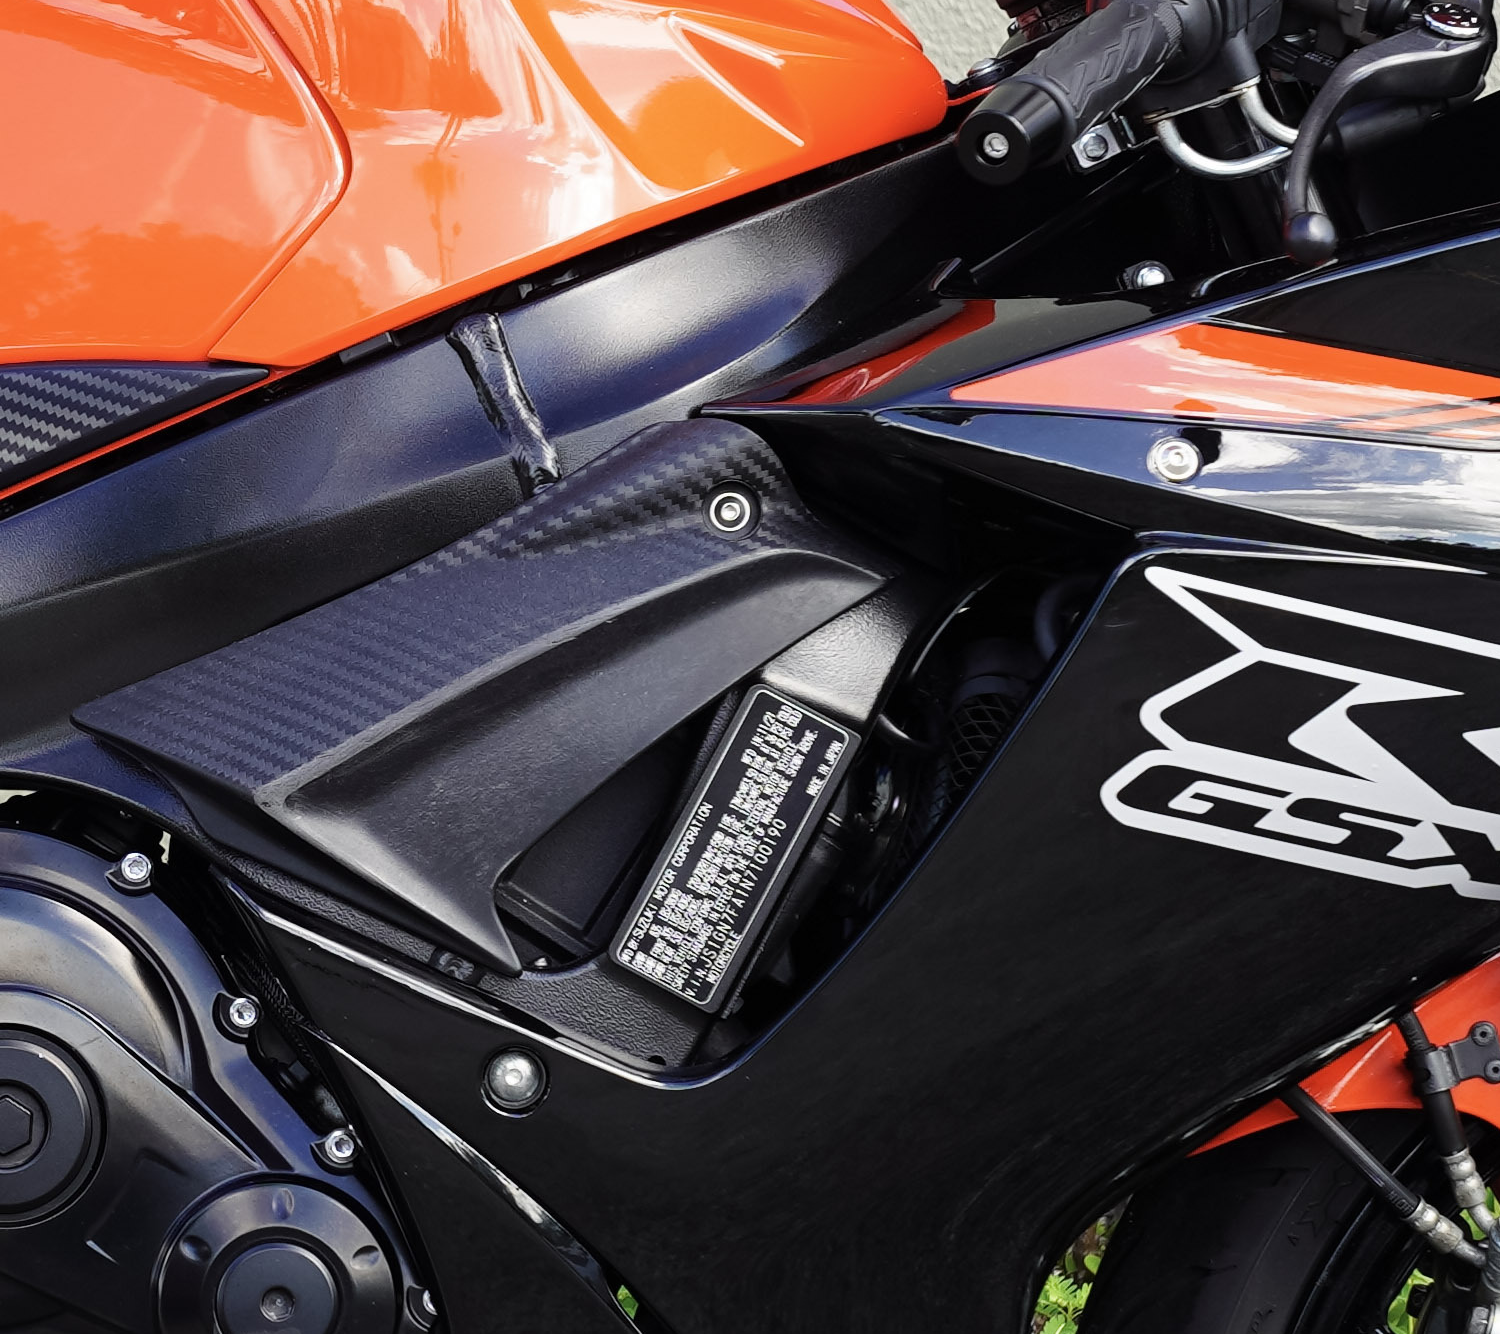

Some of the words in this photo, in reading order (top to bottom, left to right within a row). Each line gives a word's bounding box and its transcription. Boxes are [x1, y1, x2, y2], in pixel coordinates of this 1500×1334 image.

[651, 866, 678, 902] MOTOR
[669, 800, 714, 868] CORPORATION
[704, 928, 742, 985] MOTORCYCLE
